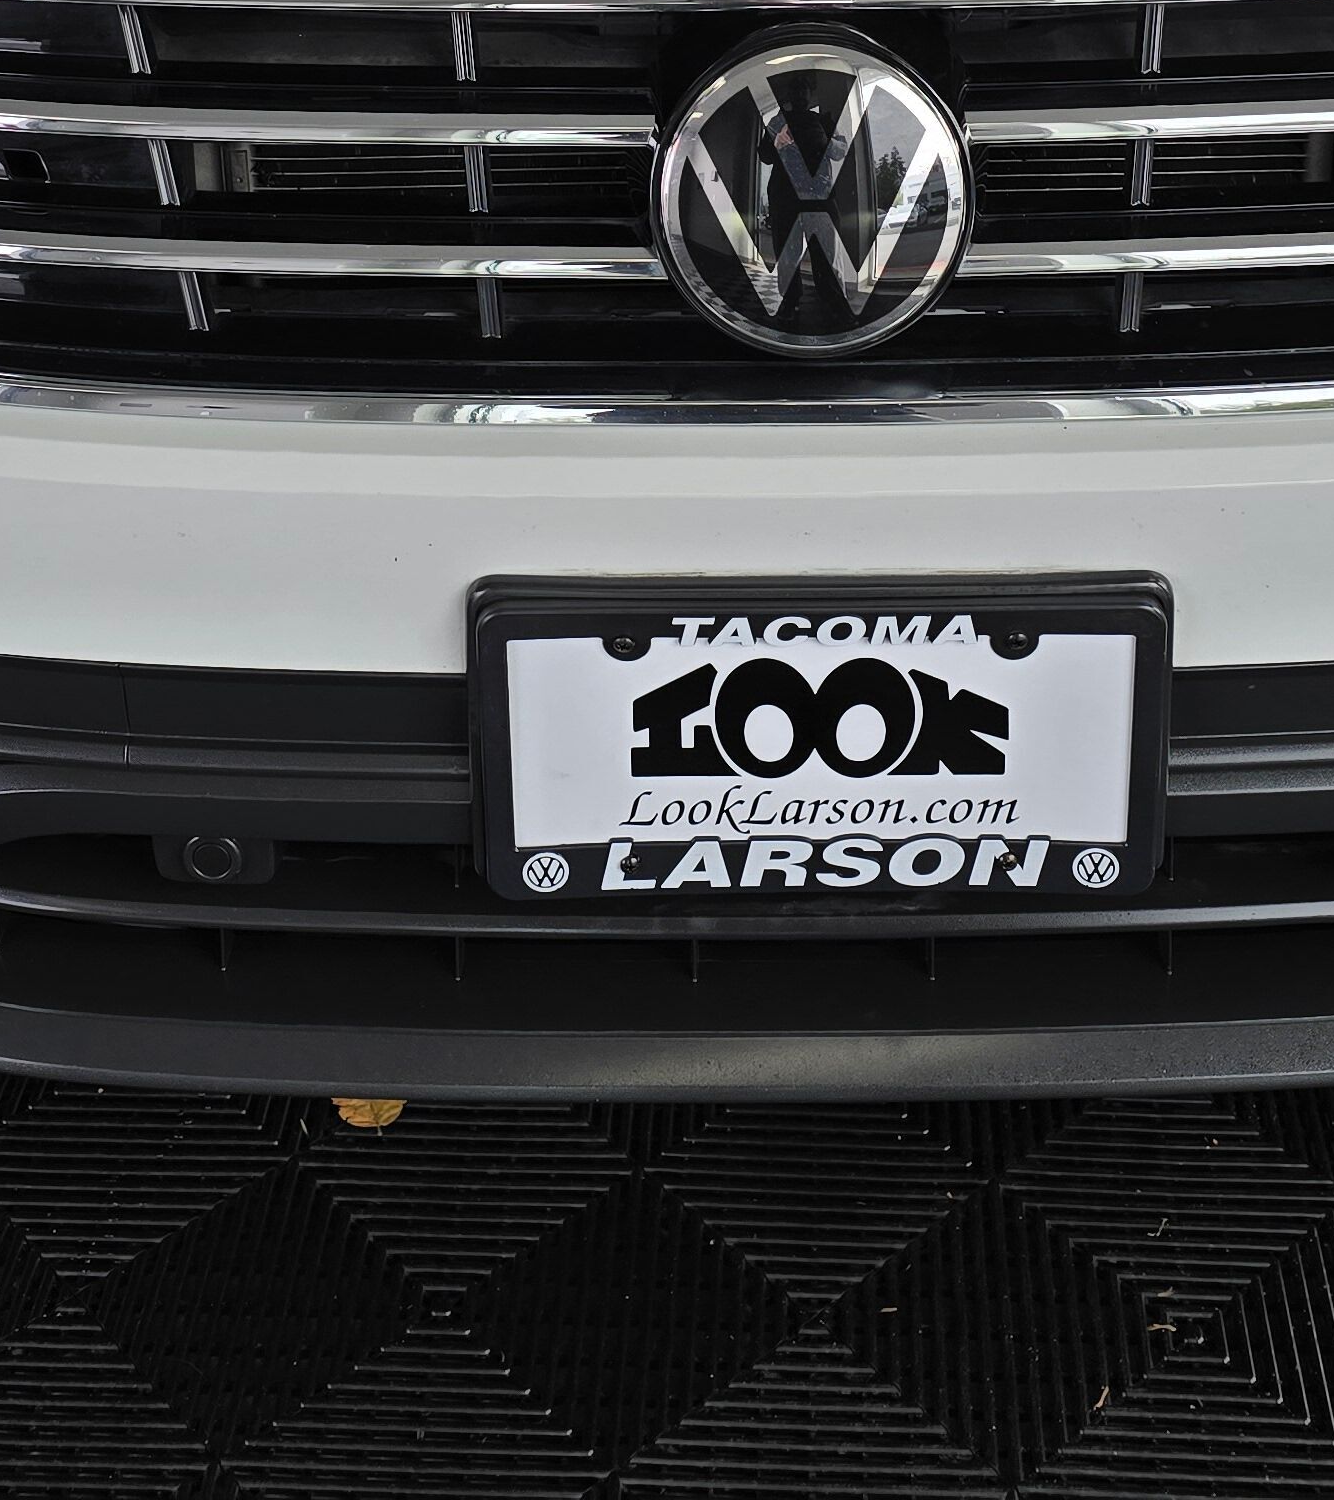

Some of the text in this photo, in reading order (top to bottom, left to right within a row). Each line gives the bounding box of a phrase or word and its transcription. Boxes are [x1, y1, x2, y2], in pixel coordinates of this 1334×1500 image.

[671, 615, 979, 647] TACOMA
[631, 657, 1009, 778] LOOK
[618, 784, 1020, 834] LookLarson.com
[600, 836, 1051, 890] LARSON
